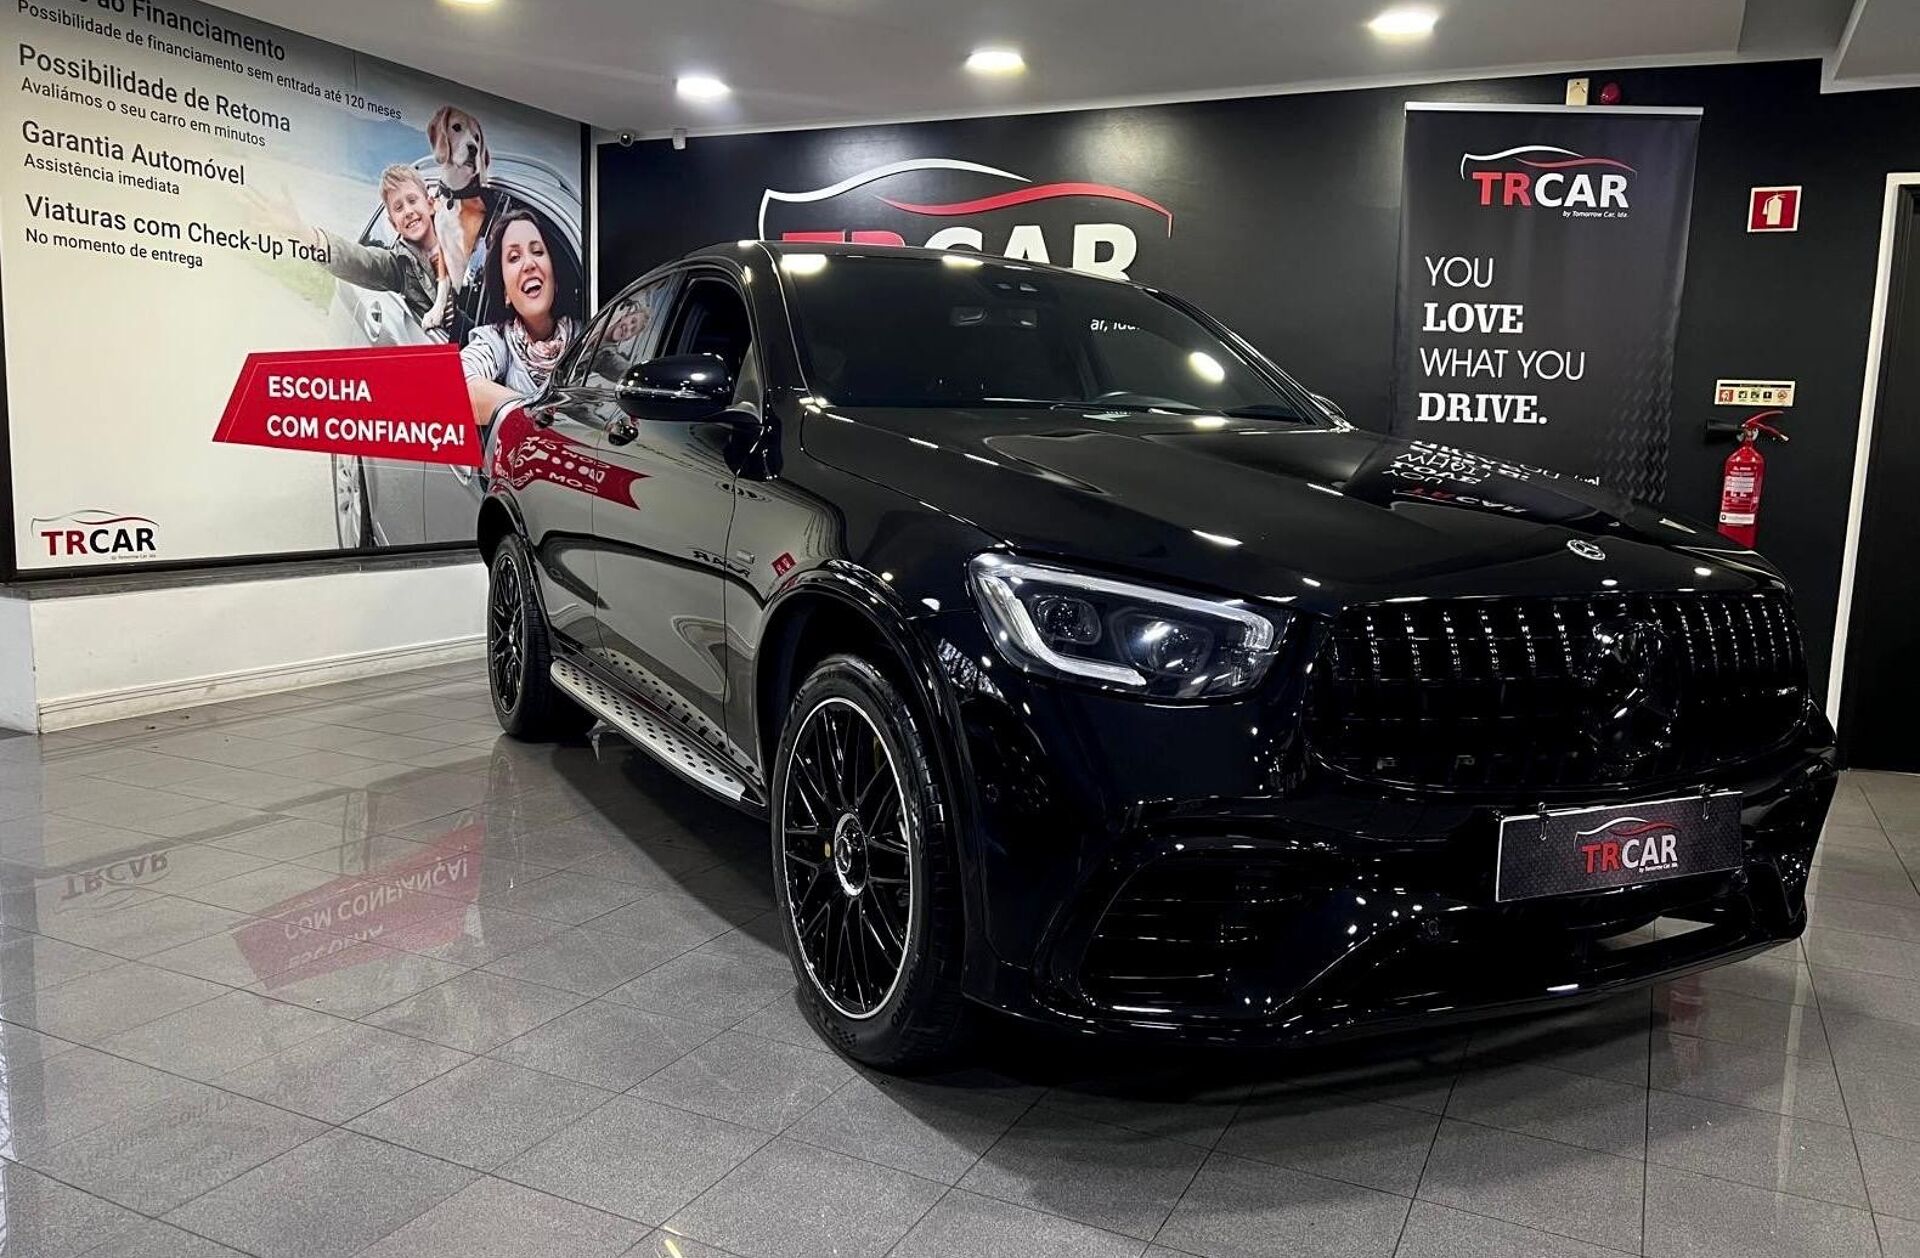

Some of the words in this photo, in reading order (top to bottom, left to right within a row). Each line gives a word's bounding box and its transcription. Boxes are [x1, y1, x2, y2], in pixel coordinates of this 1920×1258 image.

[133, 0, 285, 61] Financiamento
[18, 0, 122, 40] Possibilidade
[126, 29, 143, 46] de
[148, 34, 244, 74] financiamento
[247, 65, 273, 83] sem
[276, 75, 321, 97] entrada
[324, 88, 342, 103] até
[345, 93, 364, 110] 120
[367, 101, 402, 120] meses
[19, 43, 178, 104] Possibilidade
[184, 87, 210, 111] de
[216, 95, 290, 132] Retoma
[21, 77, 103, 109] Avaliámos
[107, 100, 116, 111] o
[120, 103, 146, 119] seu
[150, 110, 186, 128] carro
[190, 120, 211, 134] em
[214, 125, 266, 147] minutos
[22, 120, 124, 161] Garantia
[131, 143, 245, 186] Automóvel
[24, 153, 114, 183] Assistência
[118, 170, 180, 195] imediata
[1472, 171, 1629, 208] TRCAR
[25, 193, 126, 231] Viaturas
[134, 216, 181, 239] com
[188, 222, 283, 260] Check-Up
[288, 238, 332, 264] Total
[26, 228, 48, 244] No
[53, 235, 126, 256] momento
[130, 243, 148, 258] de
[151, 249, 203, 269] entrega
[1424, 256, 1494, 288] YOU
[1422, 302, 1523, 333] LOVE
[1419, 347, 1508, 379] WHAT
[1517, 350, 1586, 381] YOU
[268, 375, 372, 402] ESCOLHA
[1417, 392, 1548, 424] DRIVE.
[266, 415, 319, 439] COM
[324, 418, 465, 452] CONFIANÇA!
[40, 527, 157, 556] TRCAR
[1581, 834, 1678, 874] TRCAR
